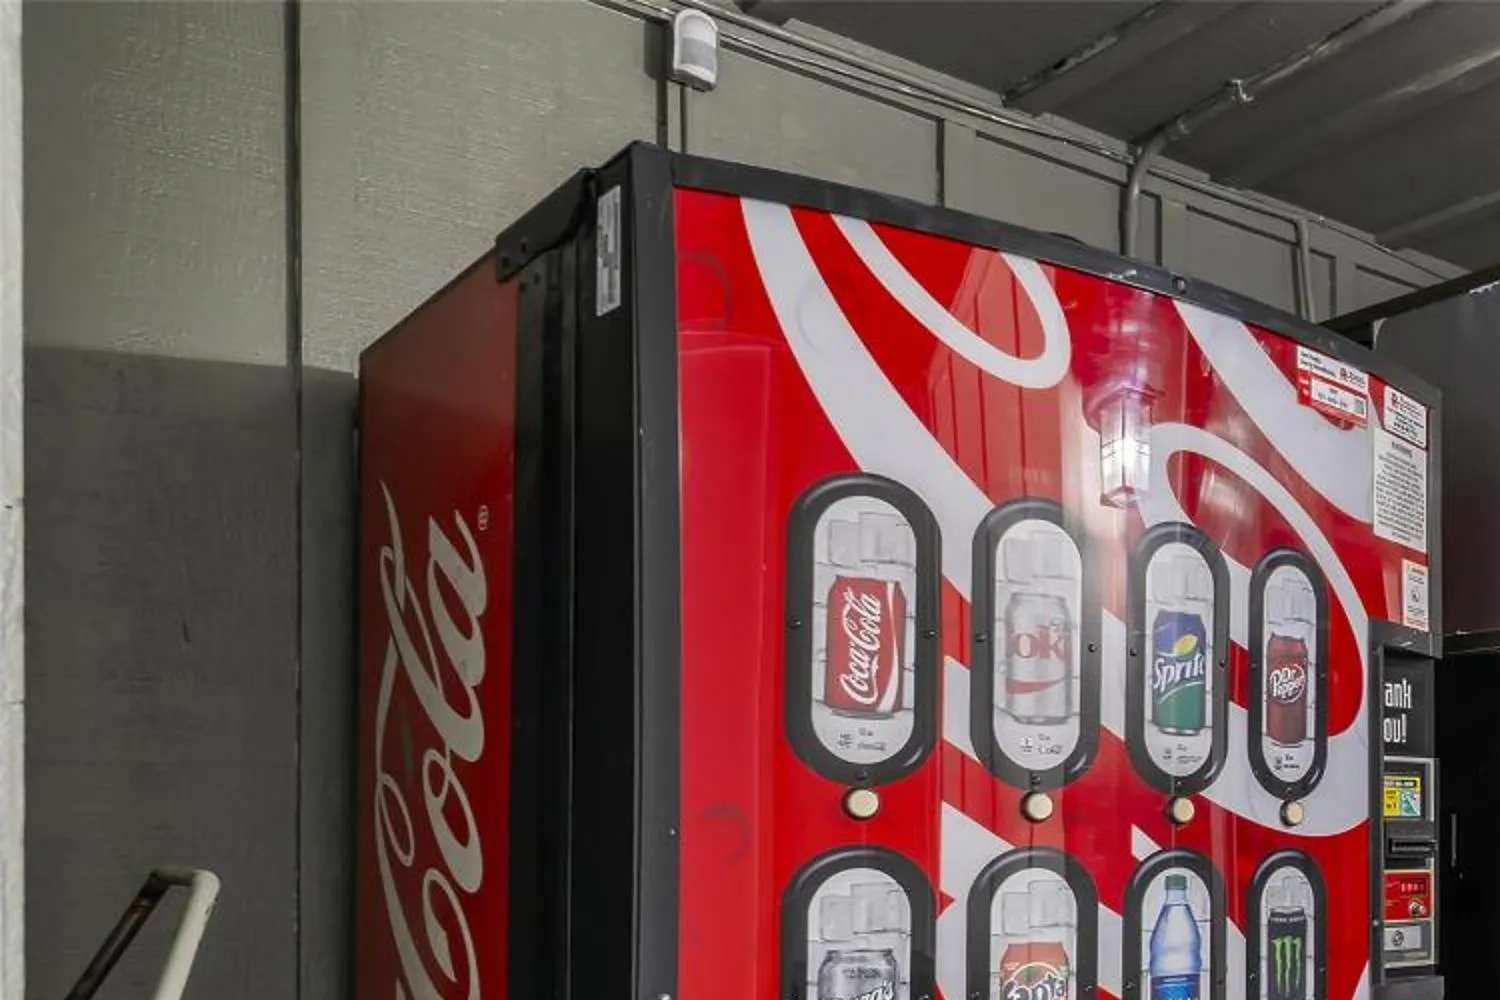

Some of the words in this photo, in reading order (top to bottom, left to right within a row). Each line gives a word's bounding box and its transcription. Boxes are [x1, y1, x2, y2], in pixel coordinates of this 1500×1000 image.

[839, 587, 881, 705] Coca-Cola
[1383, 677, 1412, 709] ank
[1383, 713, 1407, 743] ou!
